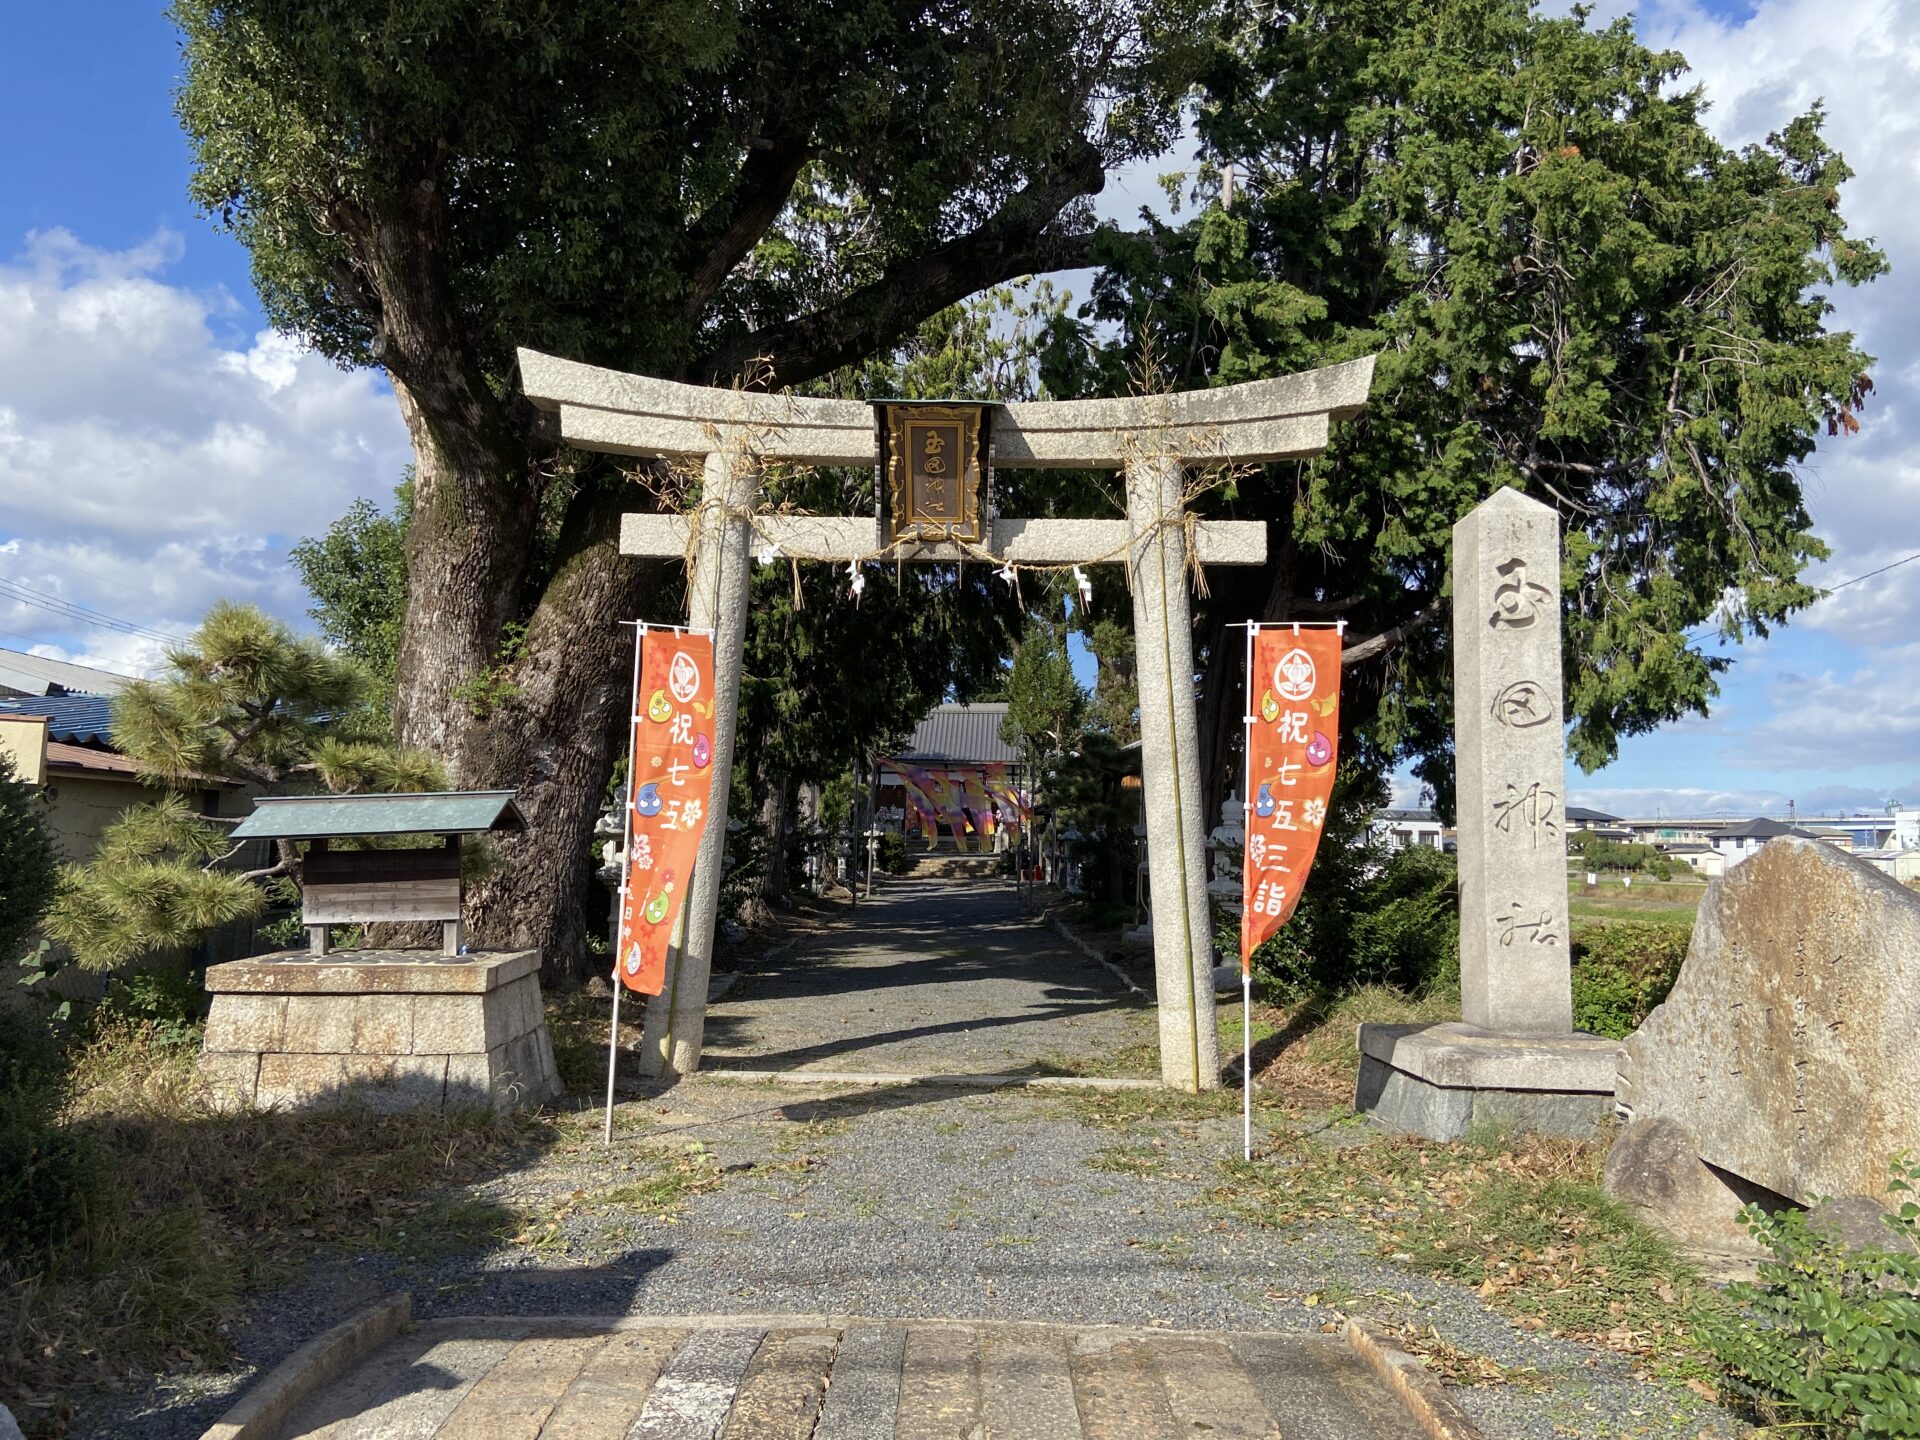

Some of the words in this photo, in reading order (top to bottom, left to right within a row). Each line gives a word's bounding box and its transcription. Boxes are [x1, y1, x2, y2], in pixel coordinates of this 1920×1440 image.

[1253, 709, 1309, 916] 祝七五三詣
